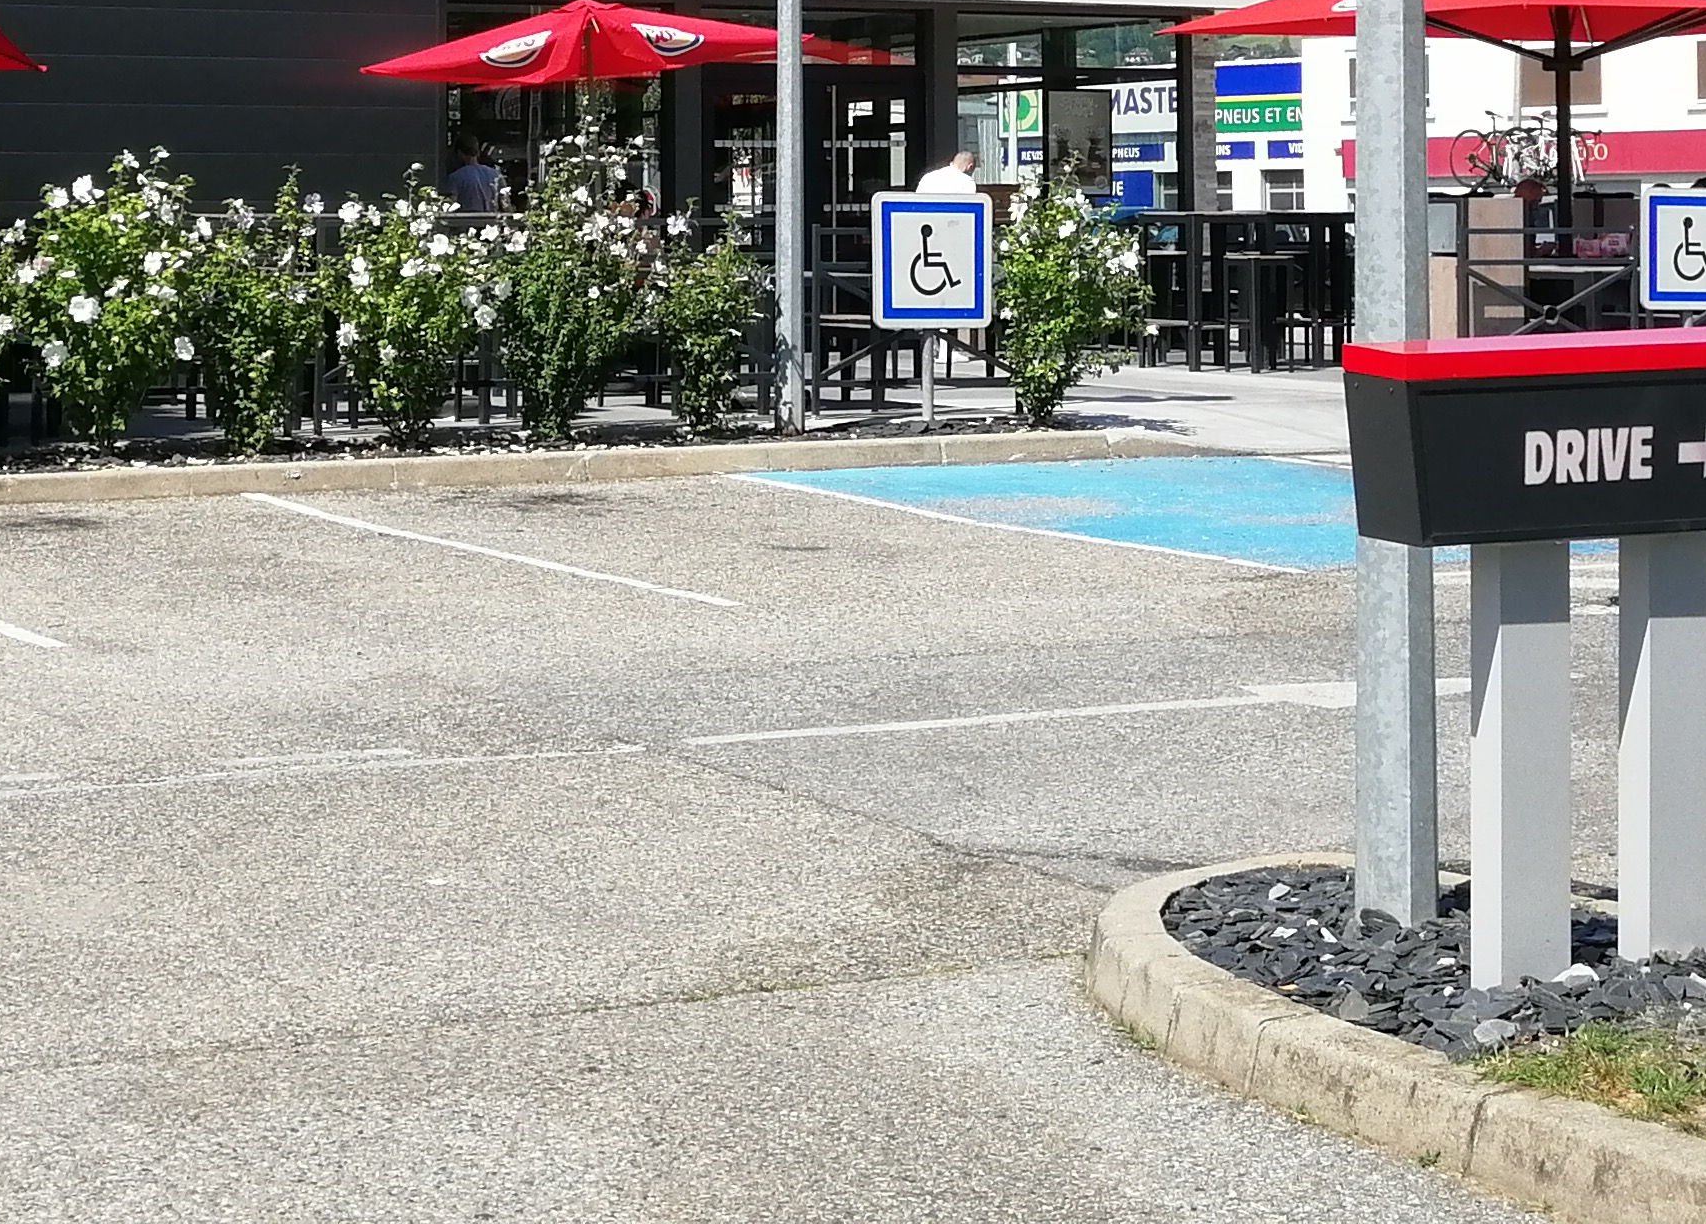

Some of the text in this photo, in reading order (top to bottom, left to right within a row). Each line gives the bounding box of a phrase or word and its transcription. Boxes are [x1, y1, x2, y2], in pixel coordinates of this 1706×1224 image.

[1215, 108, 1260, 125] PNEUS
[1265, 108, 1282, 123] ET
[1524, 426, 1654, 485] DRIVE
